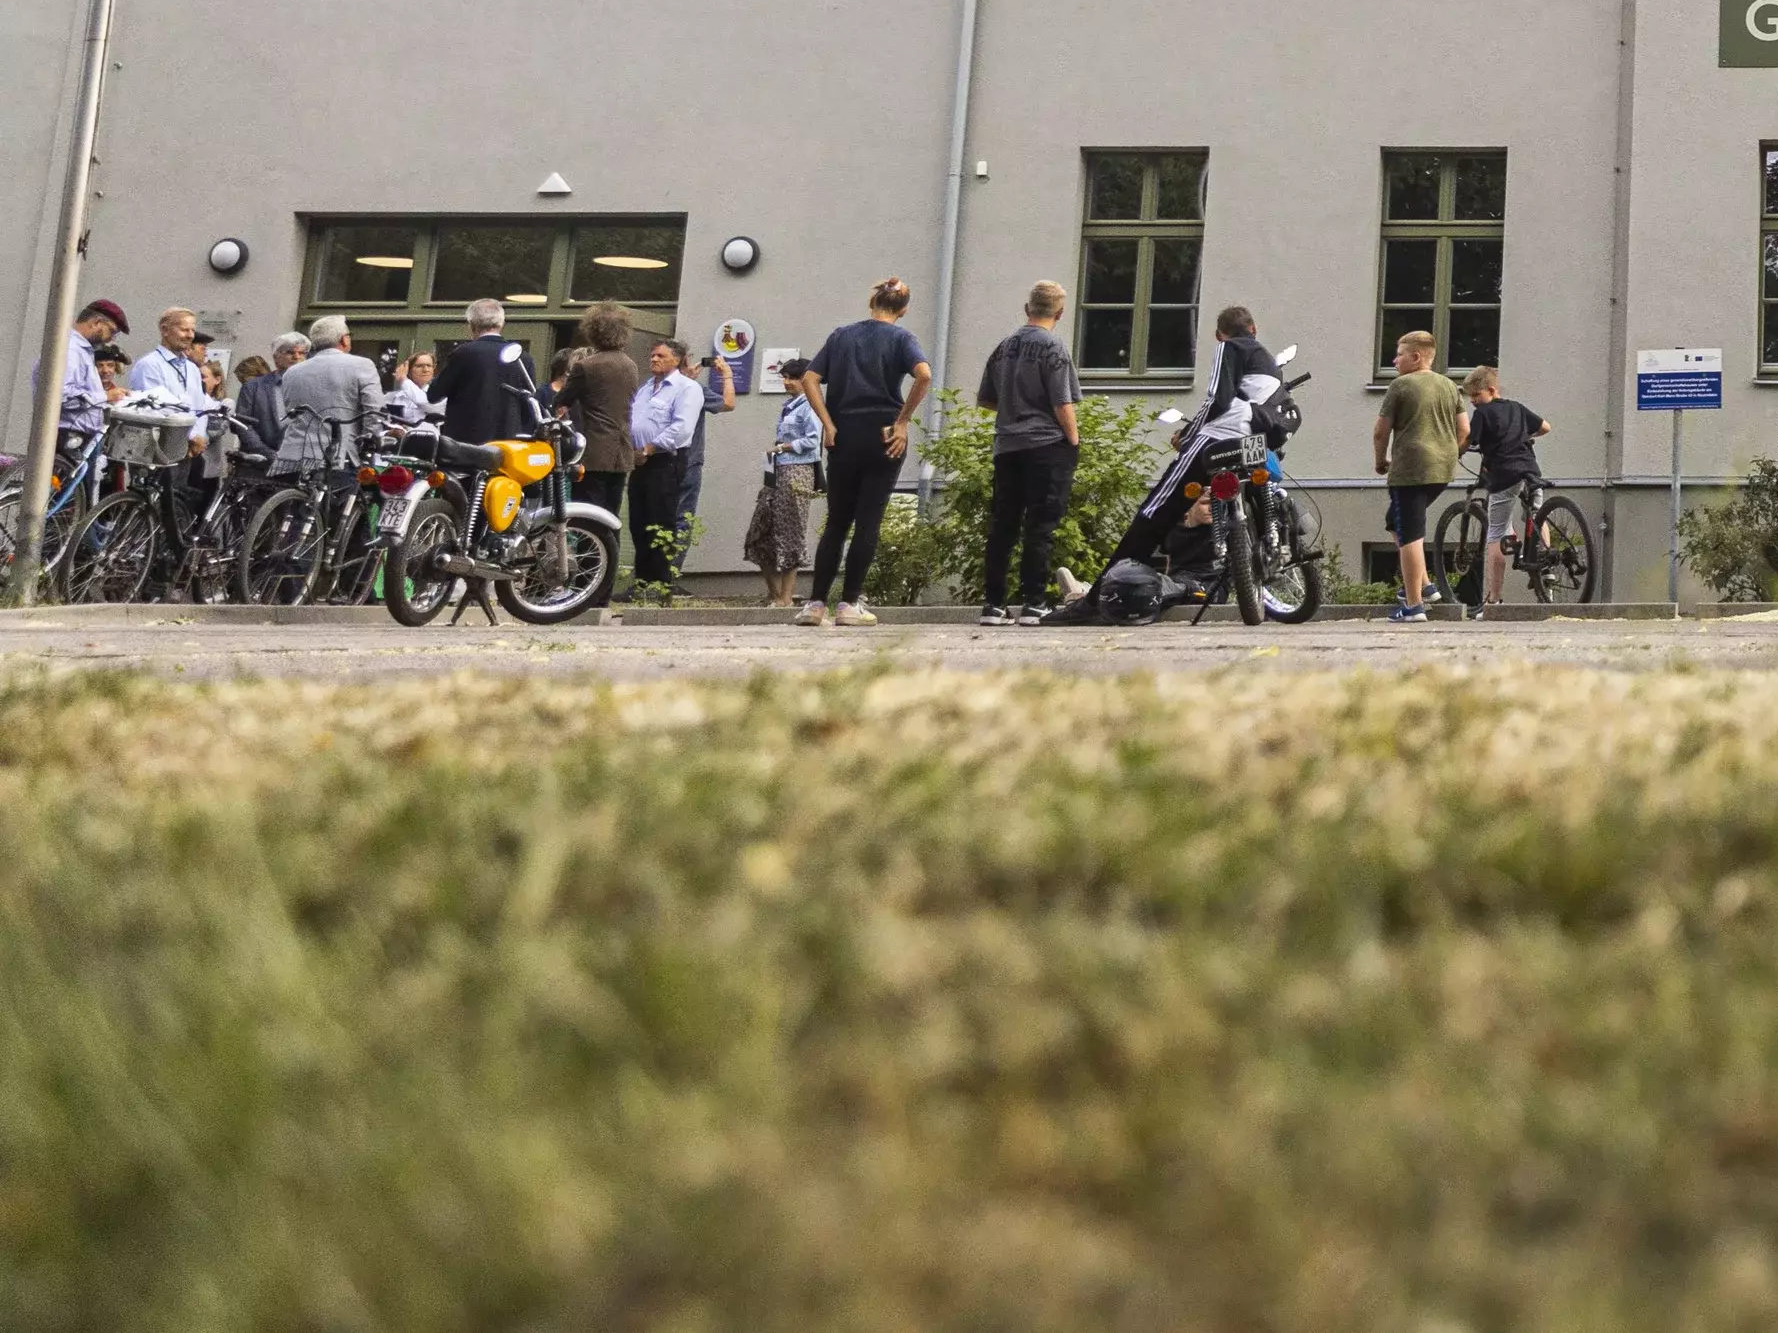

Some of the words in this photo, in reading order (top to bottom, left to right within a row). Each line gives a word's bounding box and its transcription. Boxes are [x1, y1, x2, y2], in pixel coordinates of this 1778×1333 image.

[1244, 436, 1264, 449] 479
[1210, 449, 1243, 460] simson
[1246, 449, 1266, 463] AAM
[385, 500, 408, 513] 343
[380, 511, 403, 526] KTE
